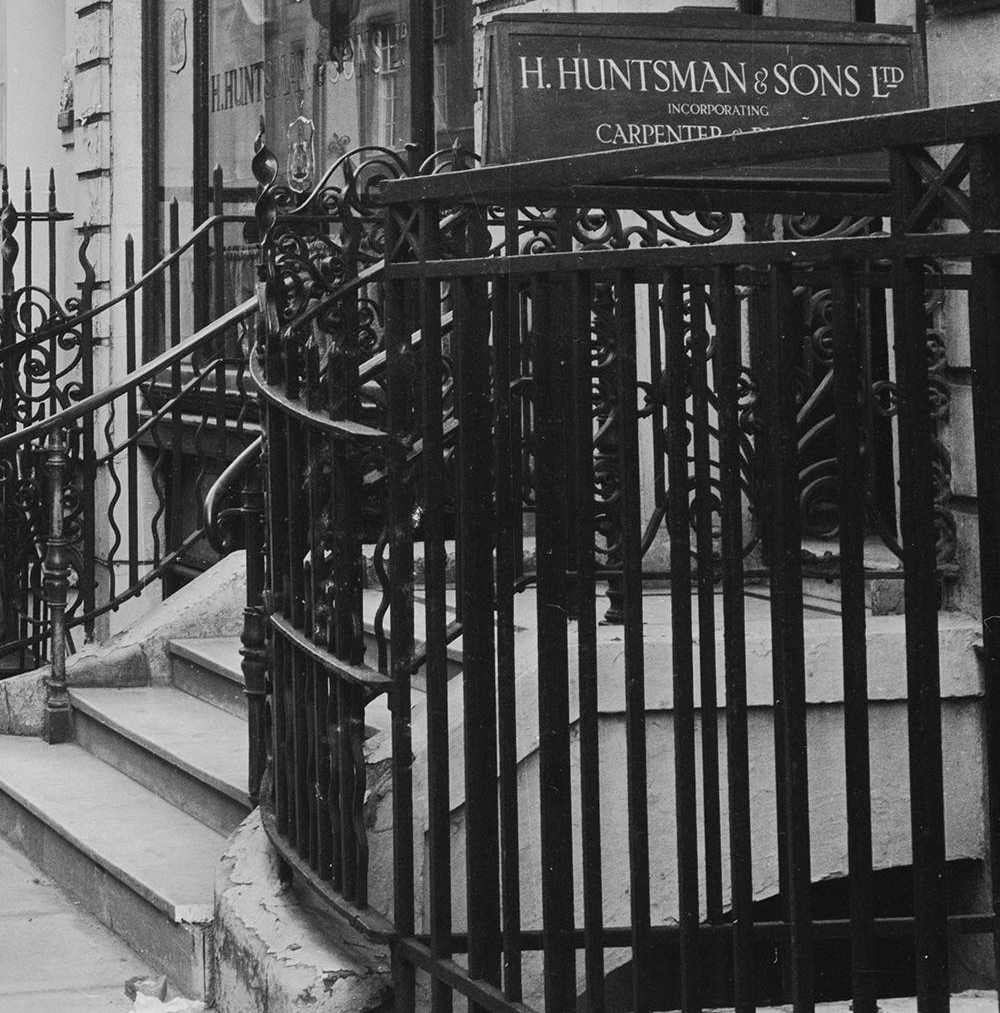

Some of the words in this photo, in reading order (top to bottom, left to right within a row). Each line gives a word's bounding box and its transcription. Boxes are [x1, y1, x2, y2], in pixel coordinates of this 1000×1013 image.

[520, 56, 552, 90] H.
[557, 57, 747, 94] HUNTSMAN
[753, 67, 769, 96] &
[773, 62, 862, 98] SONS
[667, 102, 770, 117] INCORPORATING
